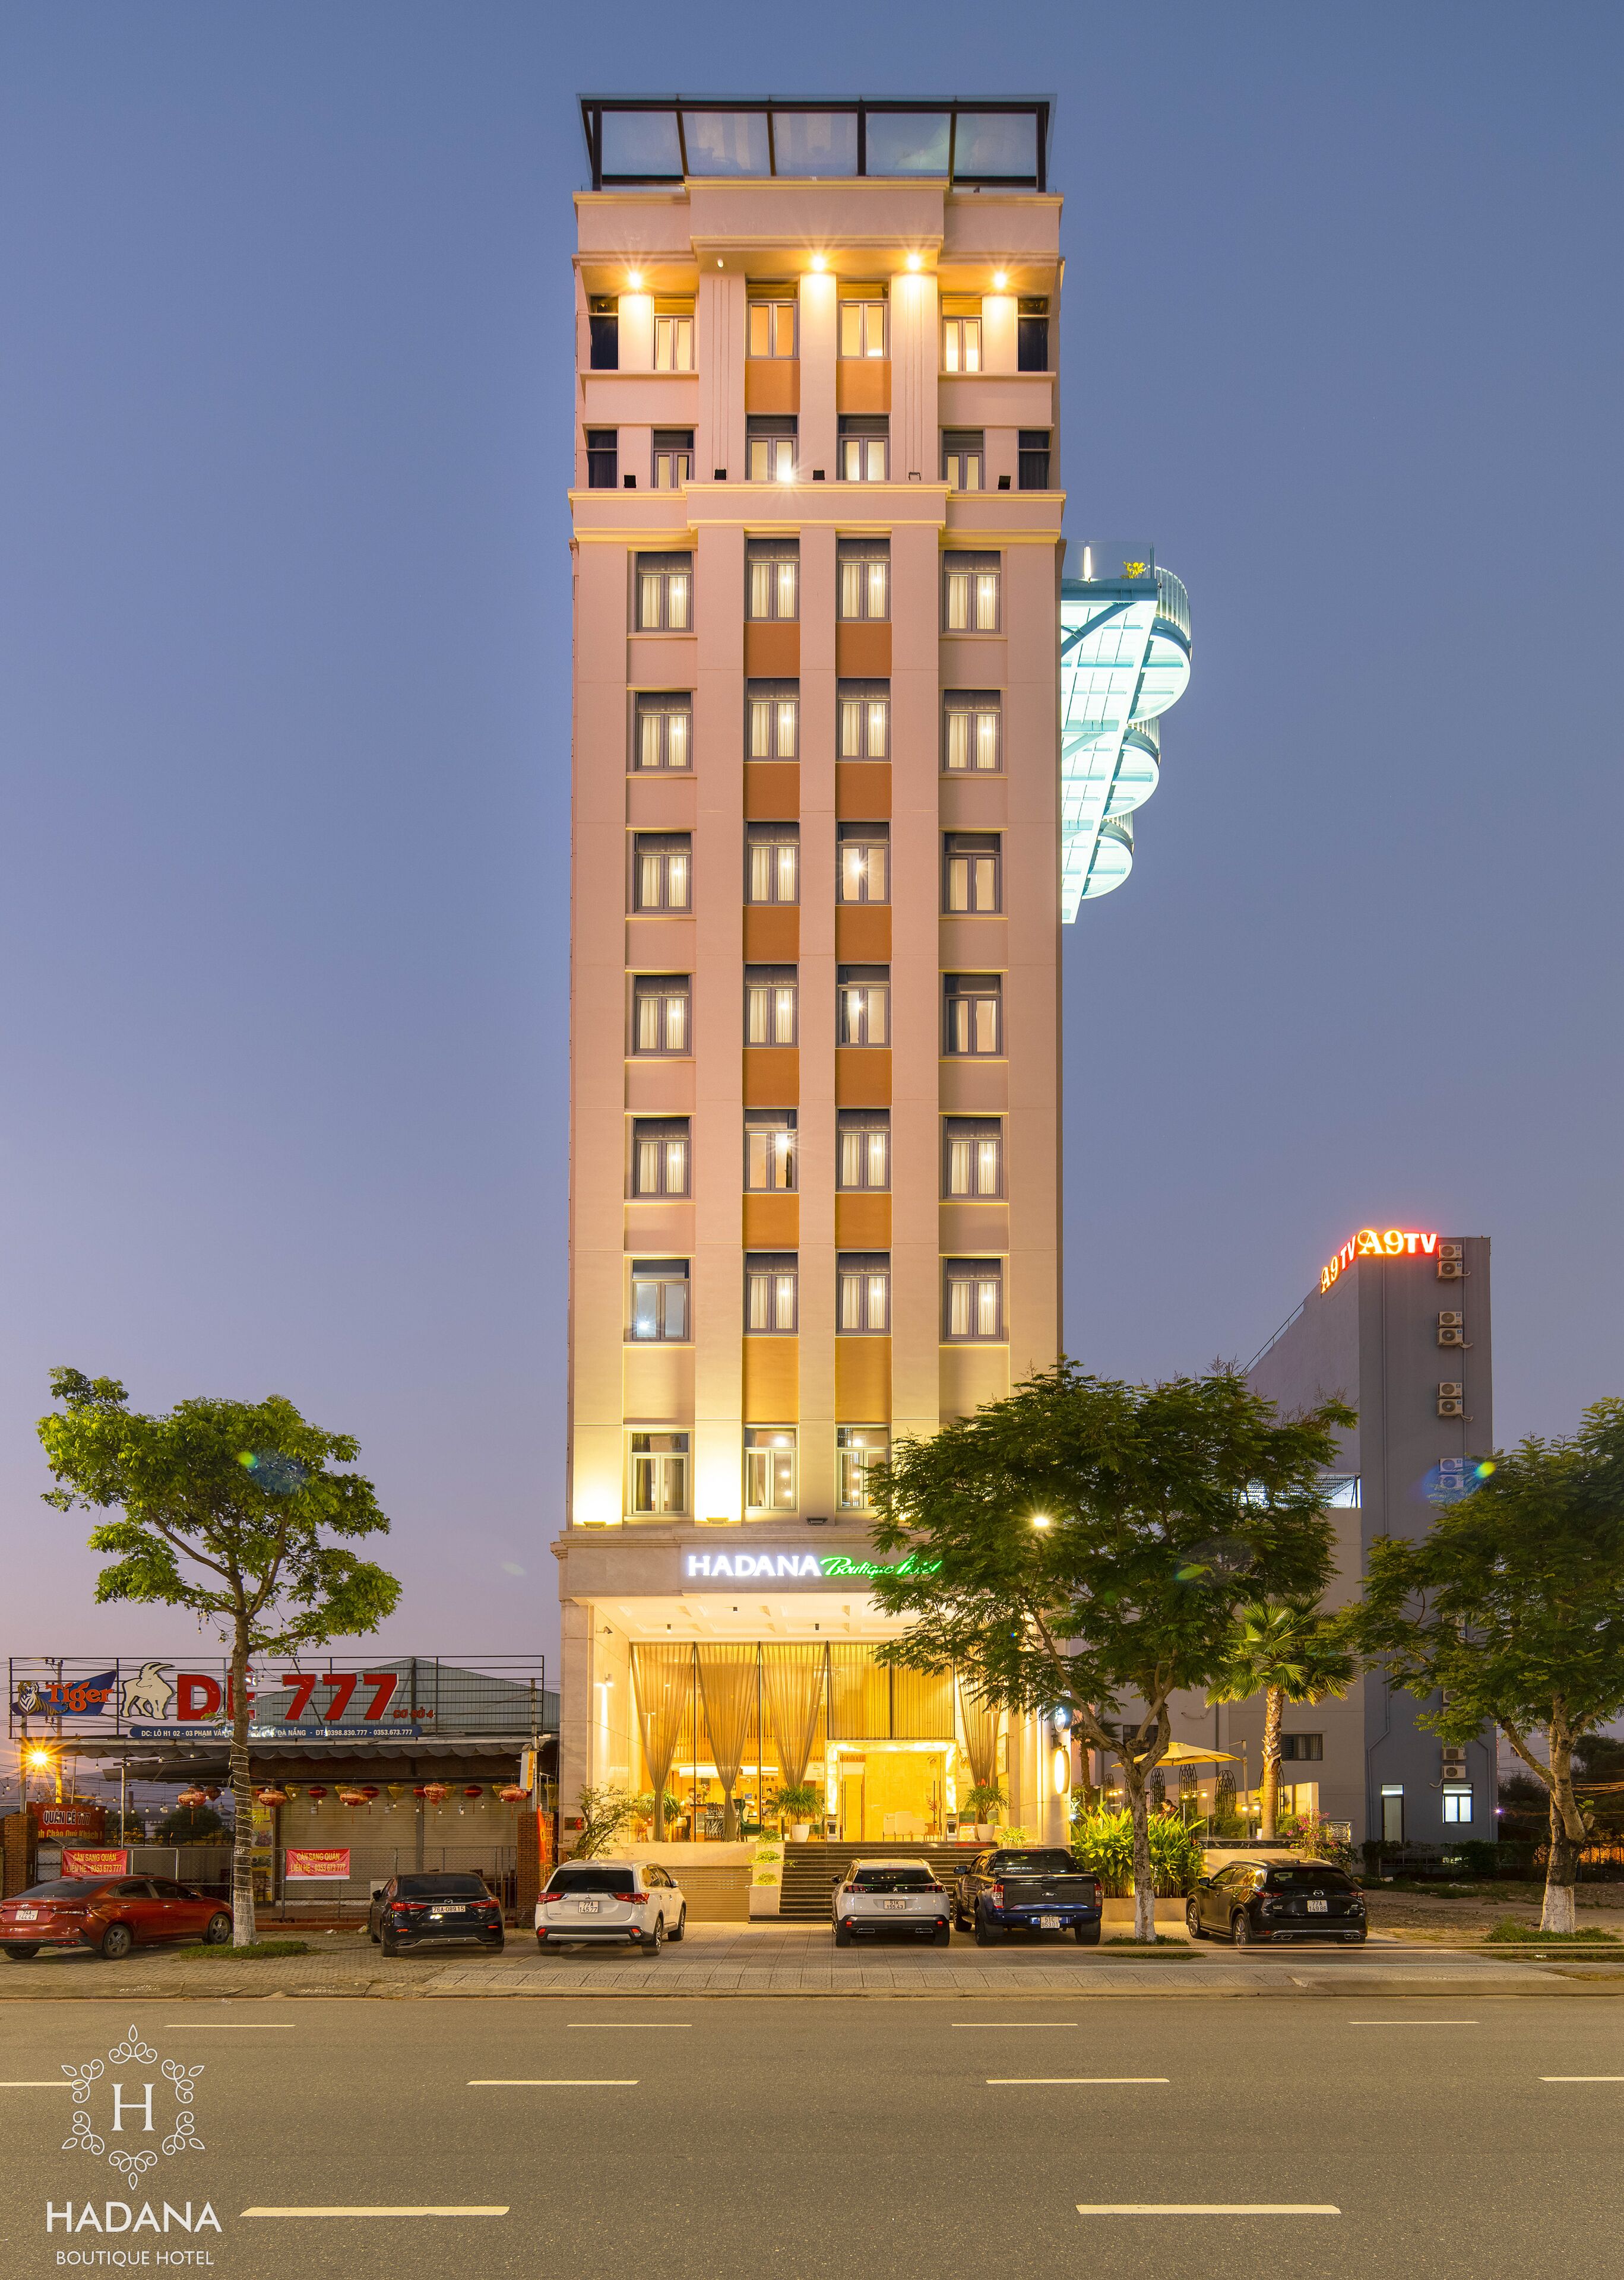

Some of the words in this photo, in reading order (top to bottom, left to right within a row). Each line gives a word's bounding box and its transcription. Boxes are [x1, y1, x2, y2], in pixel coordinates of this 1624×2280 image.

[1357, 1230, 1437, 1255] A9TV
[688, 1555, 823, 1576] HADANA
[45, 1682, 114, 1712] Tiger
[281, 1673, 399, 1721] 777
[426, 1709, 435, 1719] 4
[43, 1809, 65, 1825] QUÁN
[77, 1812, 91, 1825] 777
[85, 1853, 100, 1861] SANG
[101, 1851, 116, 1861] QUÁN
[309, 1852, 324, 1861] SANG
[324, 1850, 340, 1861] QUÁN
[103, 1864, 112, 1873] 673
[113, 1864, 122, 1873] 777
[337, 1863, 346, 1872] 777
